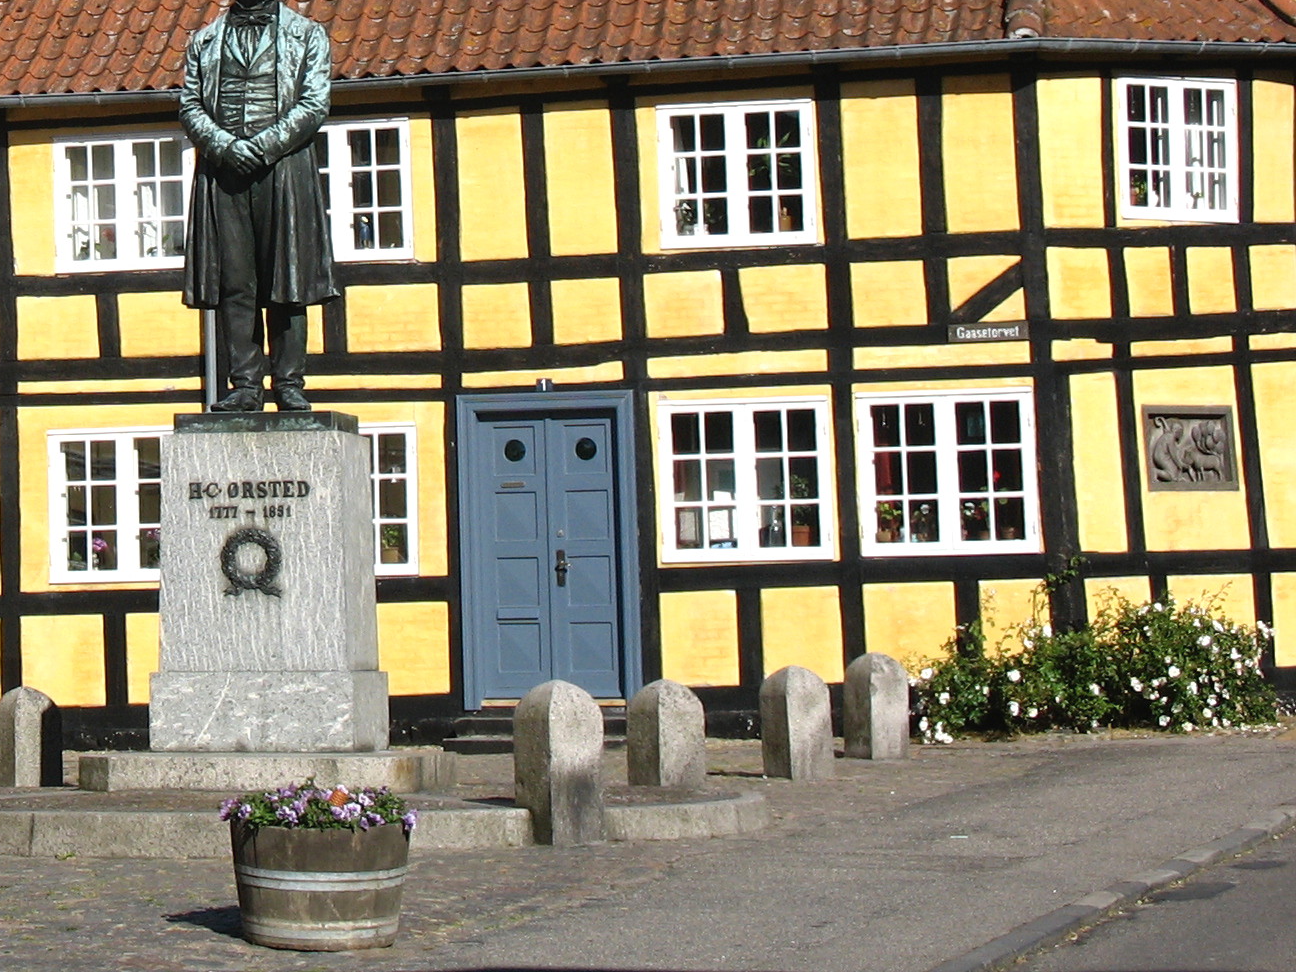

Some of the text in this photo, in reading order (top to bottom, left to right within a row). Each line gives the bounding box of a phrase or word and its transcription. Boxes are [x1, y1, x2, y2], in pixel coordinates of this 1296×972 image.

[956, 326, 1019, 339] Gaasetorvet
[227, 481, 310, 498] ØRSTED
[209, 506, 238, 519] 1777
